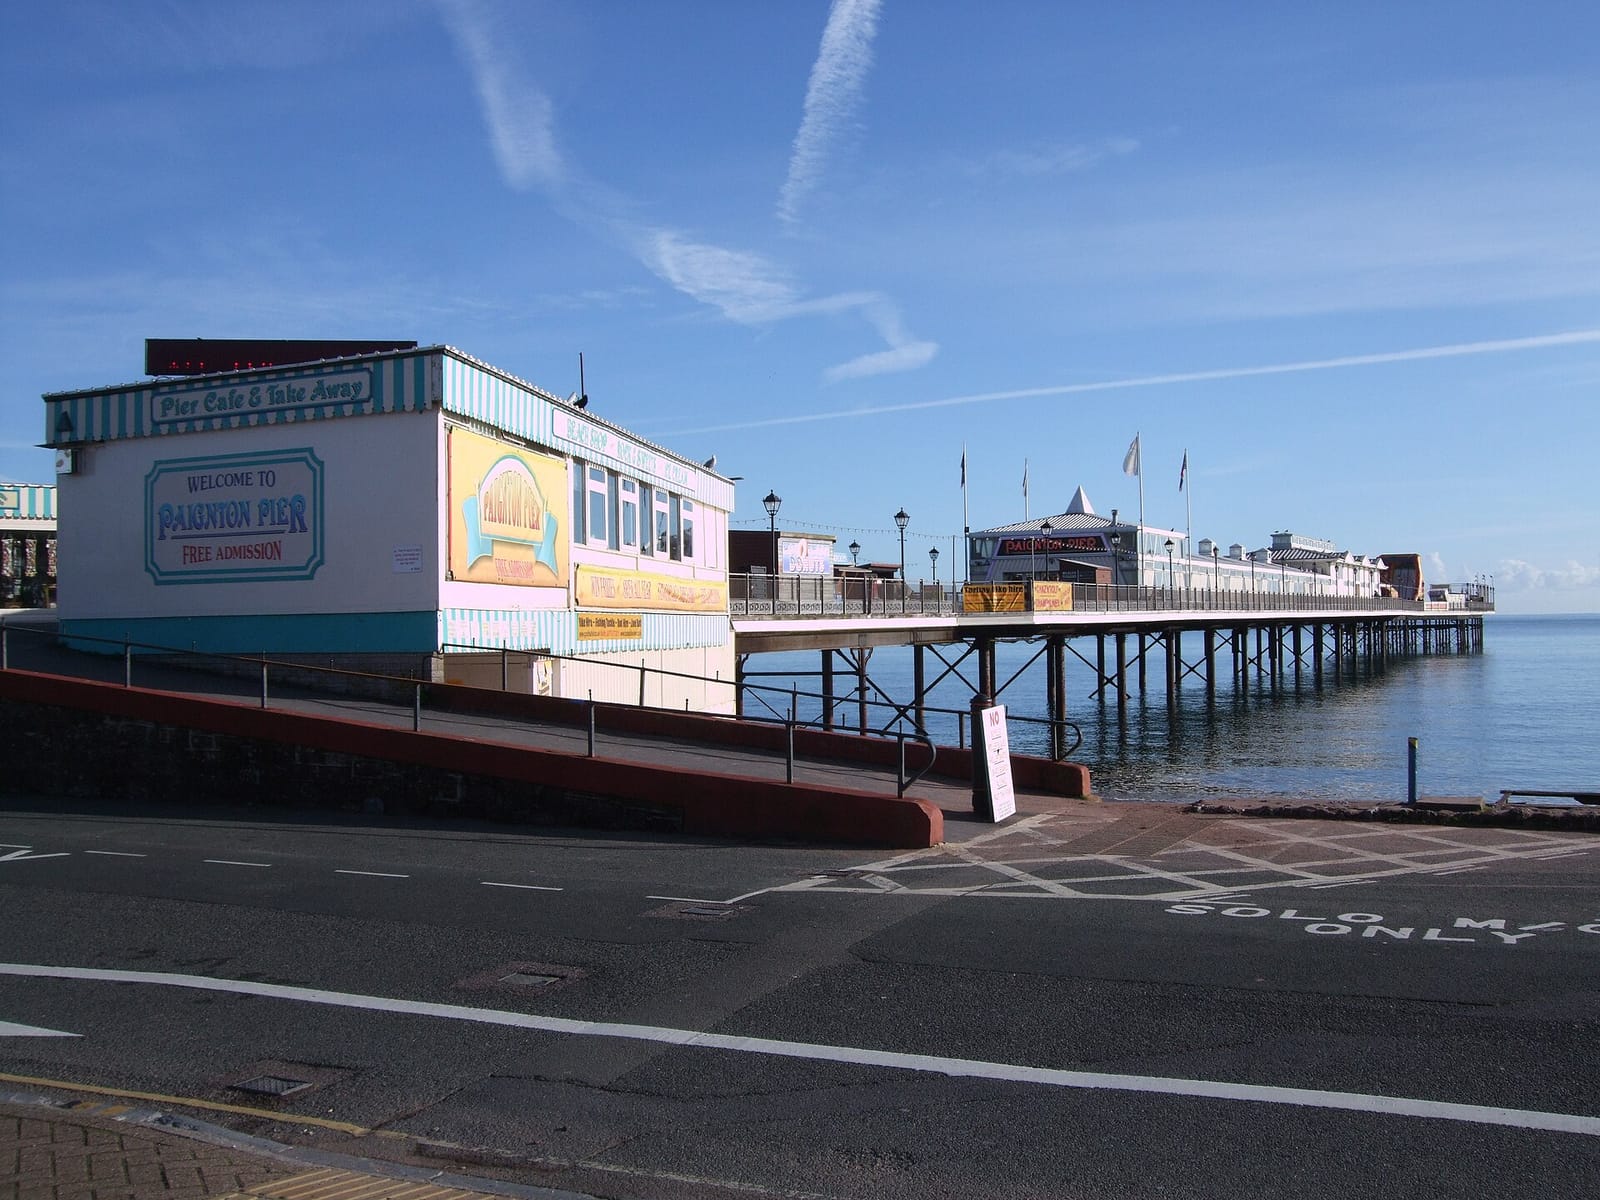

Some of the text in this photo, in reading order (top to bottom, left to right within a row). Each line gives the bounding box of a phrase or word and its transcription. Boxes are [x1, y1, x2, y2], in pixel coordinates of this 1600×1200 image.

[160, 379, 363, 417] Pier Cafe & Take Away
[188, 470, 276, 494] WELCOME TO
[484, 470, 521, 527] PAIGNTON
[158, 494, 308, 540] PAIGNTON PIER
[183, 541, 282, 565] FREE ADMISSION
[1006, 536, 1096, 553] PAIGNTON PIER
[790, 556, 825, 572] DONUTS
[989, 711, 999, 727] NO
[1165, 904, 1384, 923] SOLO
[1304, 923, 1536, 944] ONLY
